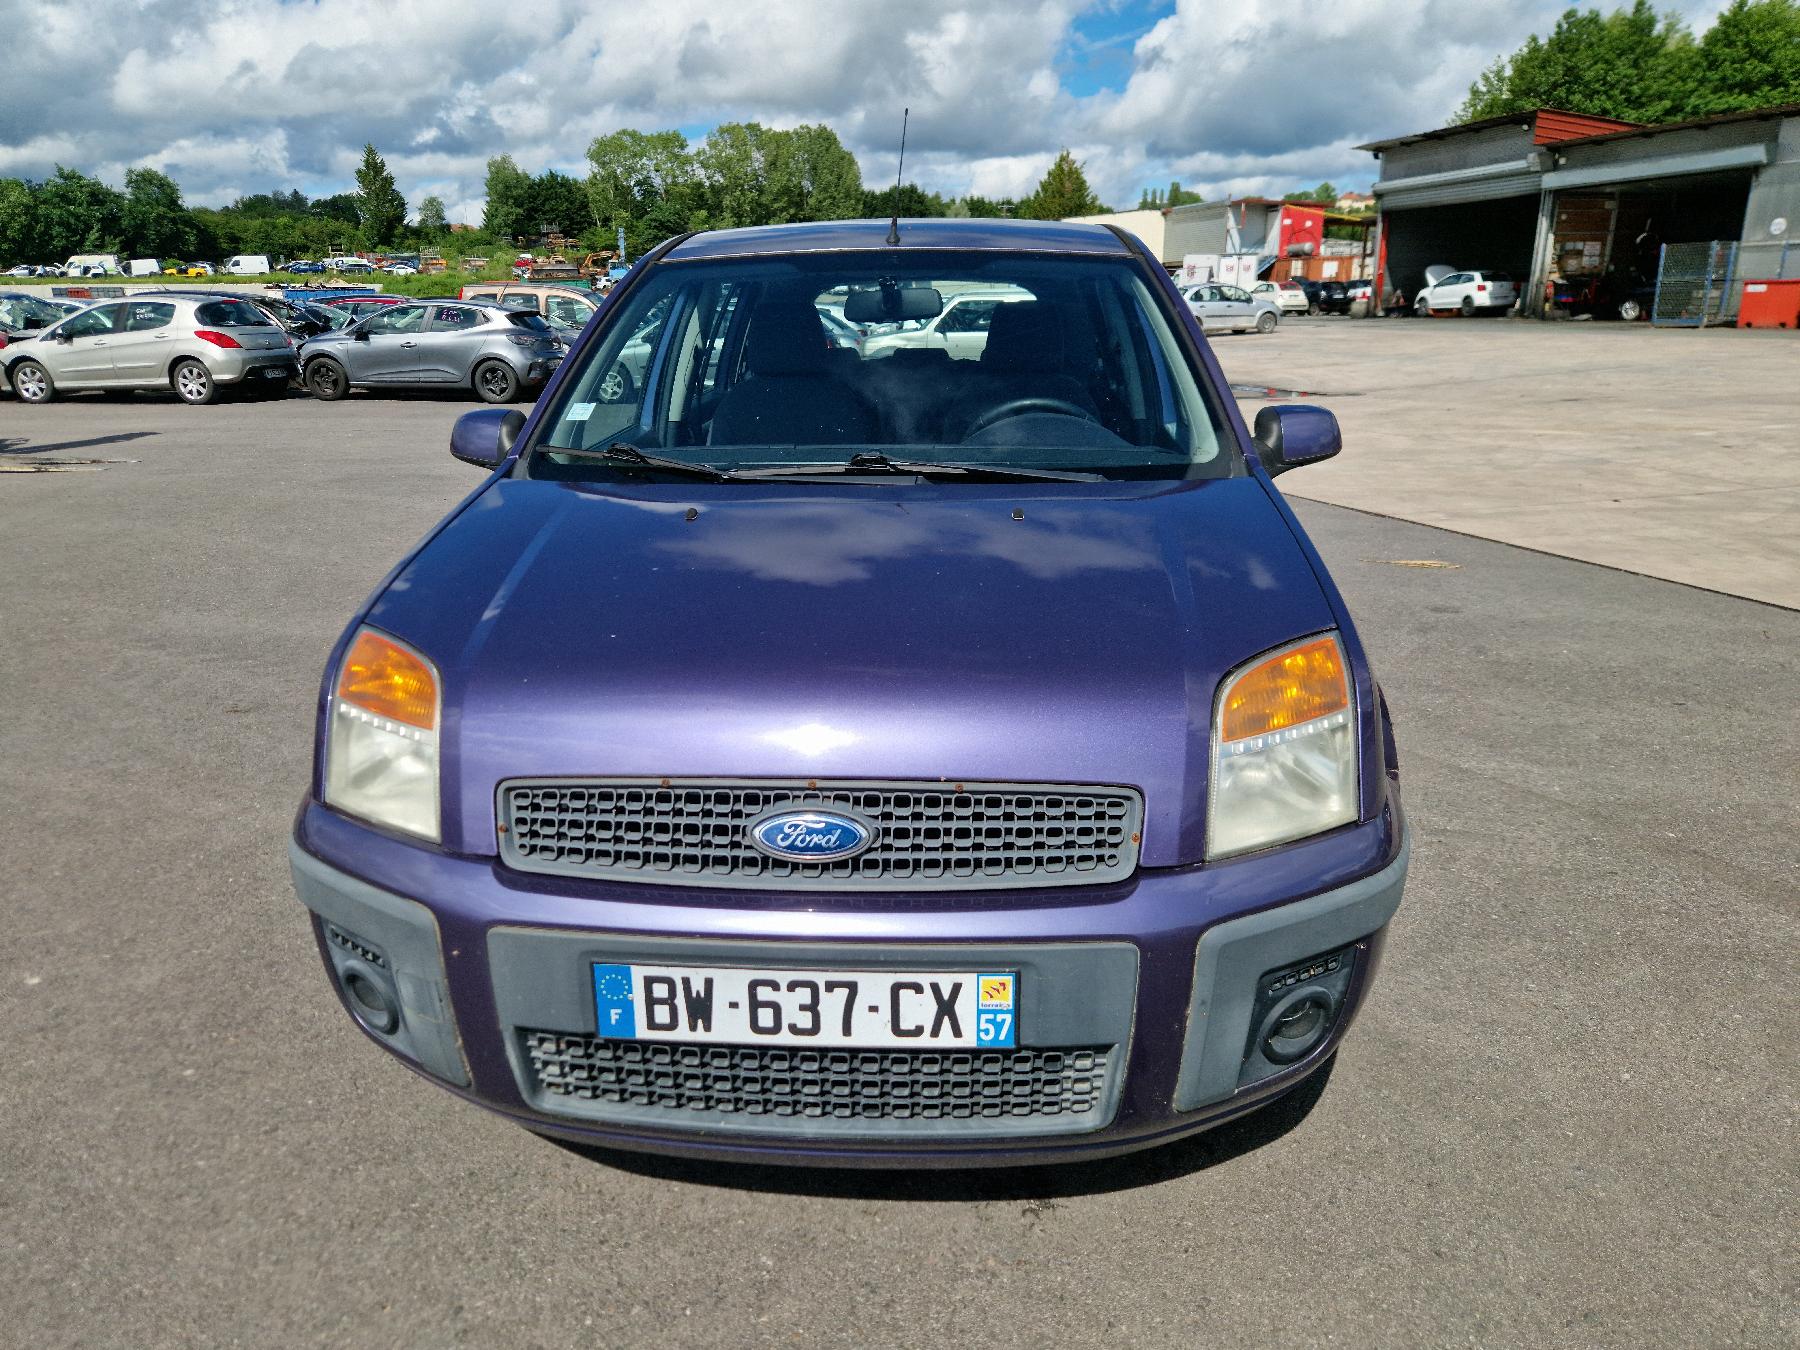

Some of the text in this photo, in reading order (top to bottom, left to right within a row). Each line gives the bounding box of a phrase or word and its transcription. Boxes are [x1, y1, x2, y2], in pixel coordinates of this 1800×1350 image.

[777, 820, 841, 848] Ford
[610, 1008, 622, 1025] F
[643, 975, 963, 1038] BW-637-CX
[979, 1013, 1012, 1041] 57
